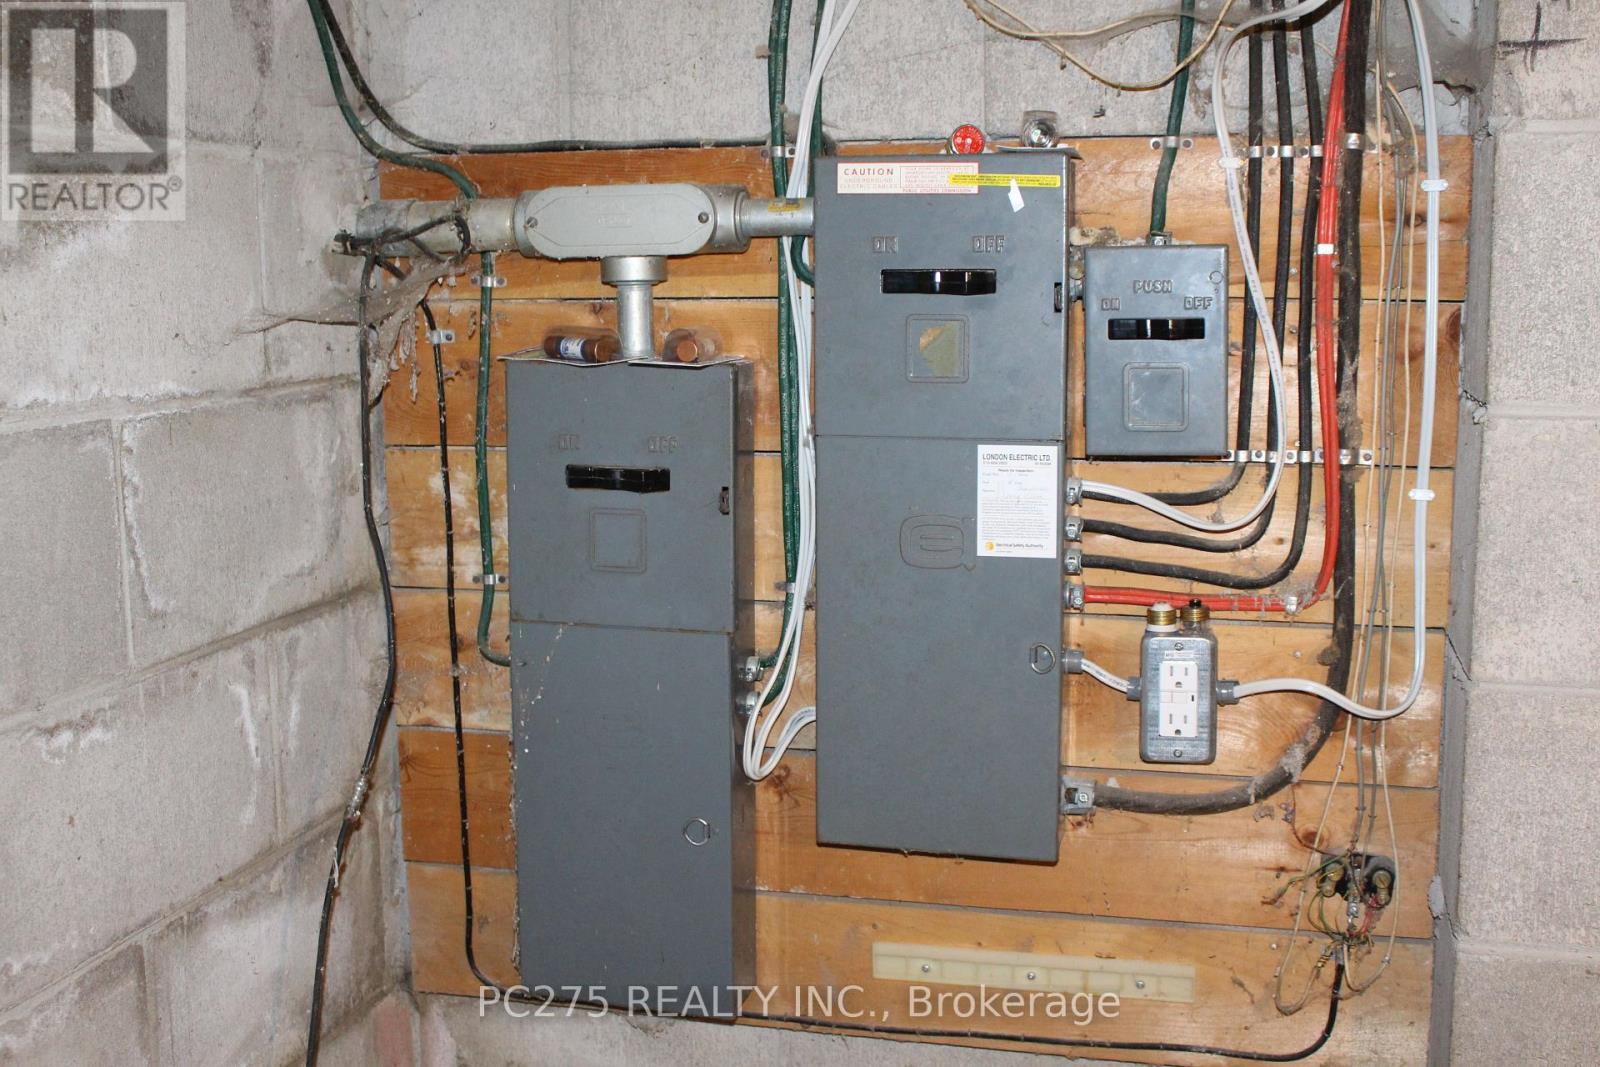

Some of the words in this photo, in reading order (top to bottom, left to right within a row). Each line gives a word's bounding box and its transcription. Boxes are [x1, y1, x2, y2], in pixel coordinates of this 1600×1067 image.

[843, 167, 894, 176] CAUTION
[971, 235, 1005, 253] OFF
[1133, 279, 1173, 294] PUSH
[1101, 297, 1120, 311] ON
[1183, 296, 1213, 310] OFF
[982, 453, 1008, 461] LONDON
